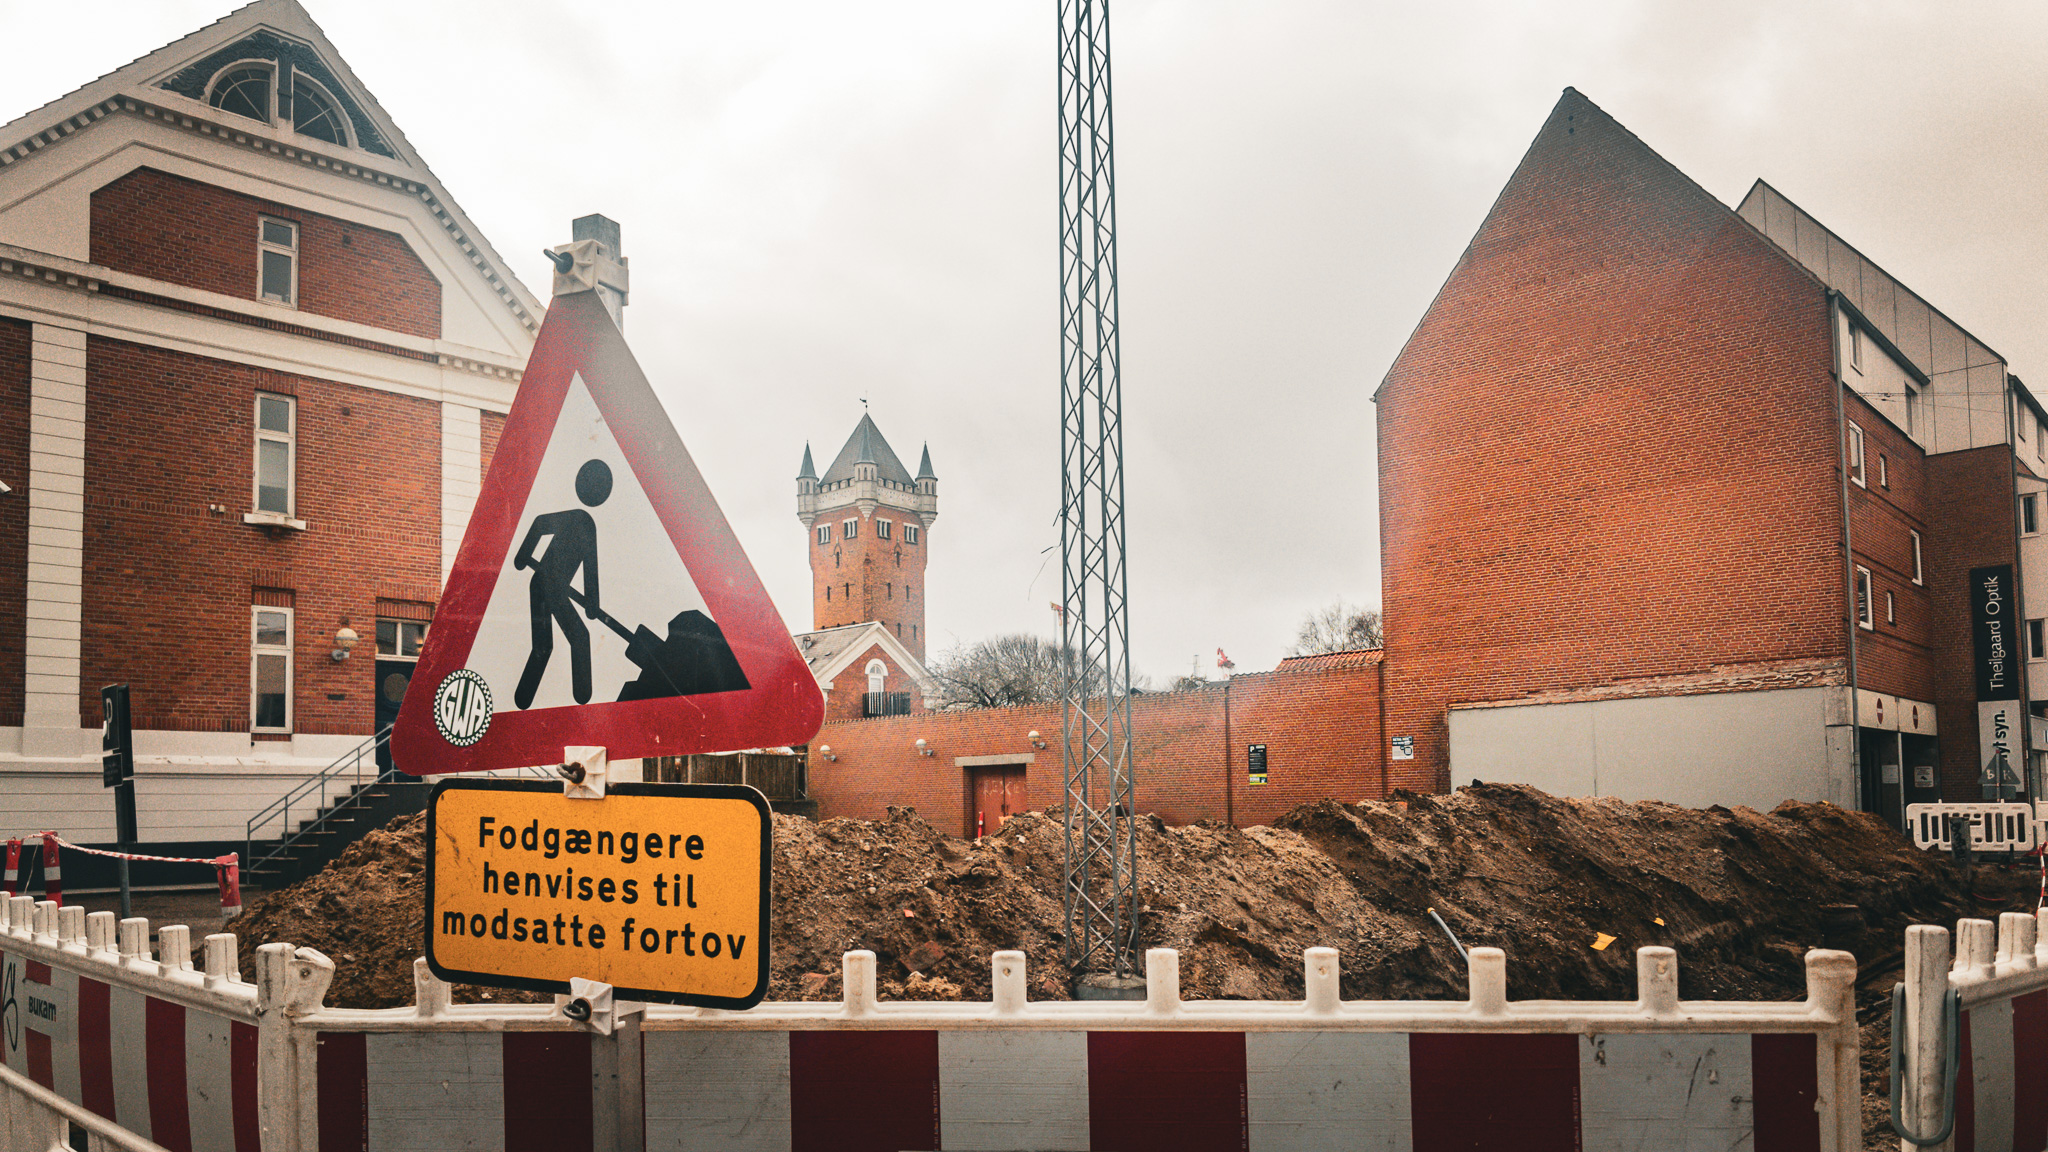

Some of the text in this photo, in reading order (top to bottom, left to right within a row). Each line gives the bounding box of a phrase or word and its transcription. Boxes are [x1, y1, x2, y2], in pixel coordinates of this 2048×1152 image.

[1983, 575, 2006, 691] Theilgaard Optik
[1994, 709, 2010, 739] syn.
[478, 816, 705, 863] Fodgængere
[482, 861, 698, 908] henvises til
[442, 908, 747, 960] modsatte fortov
